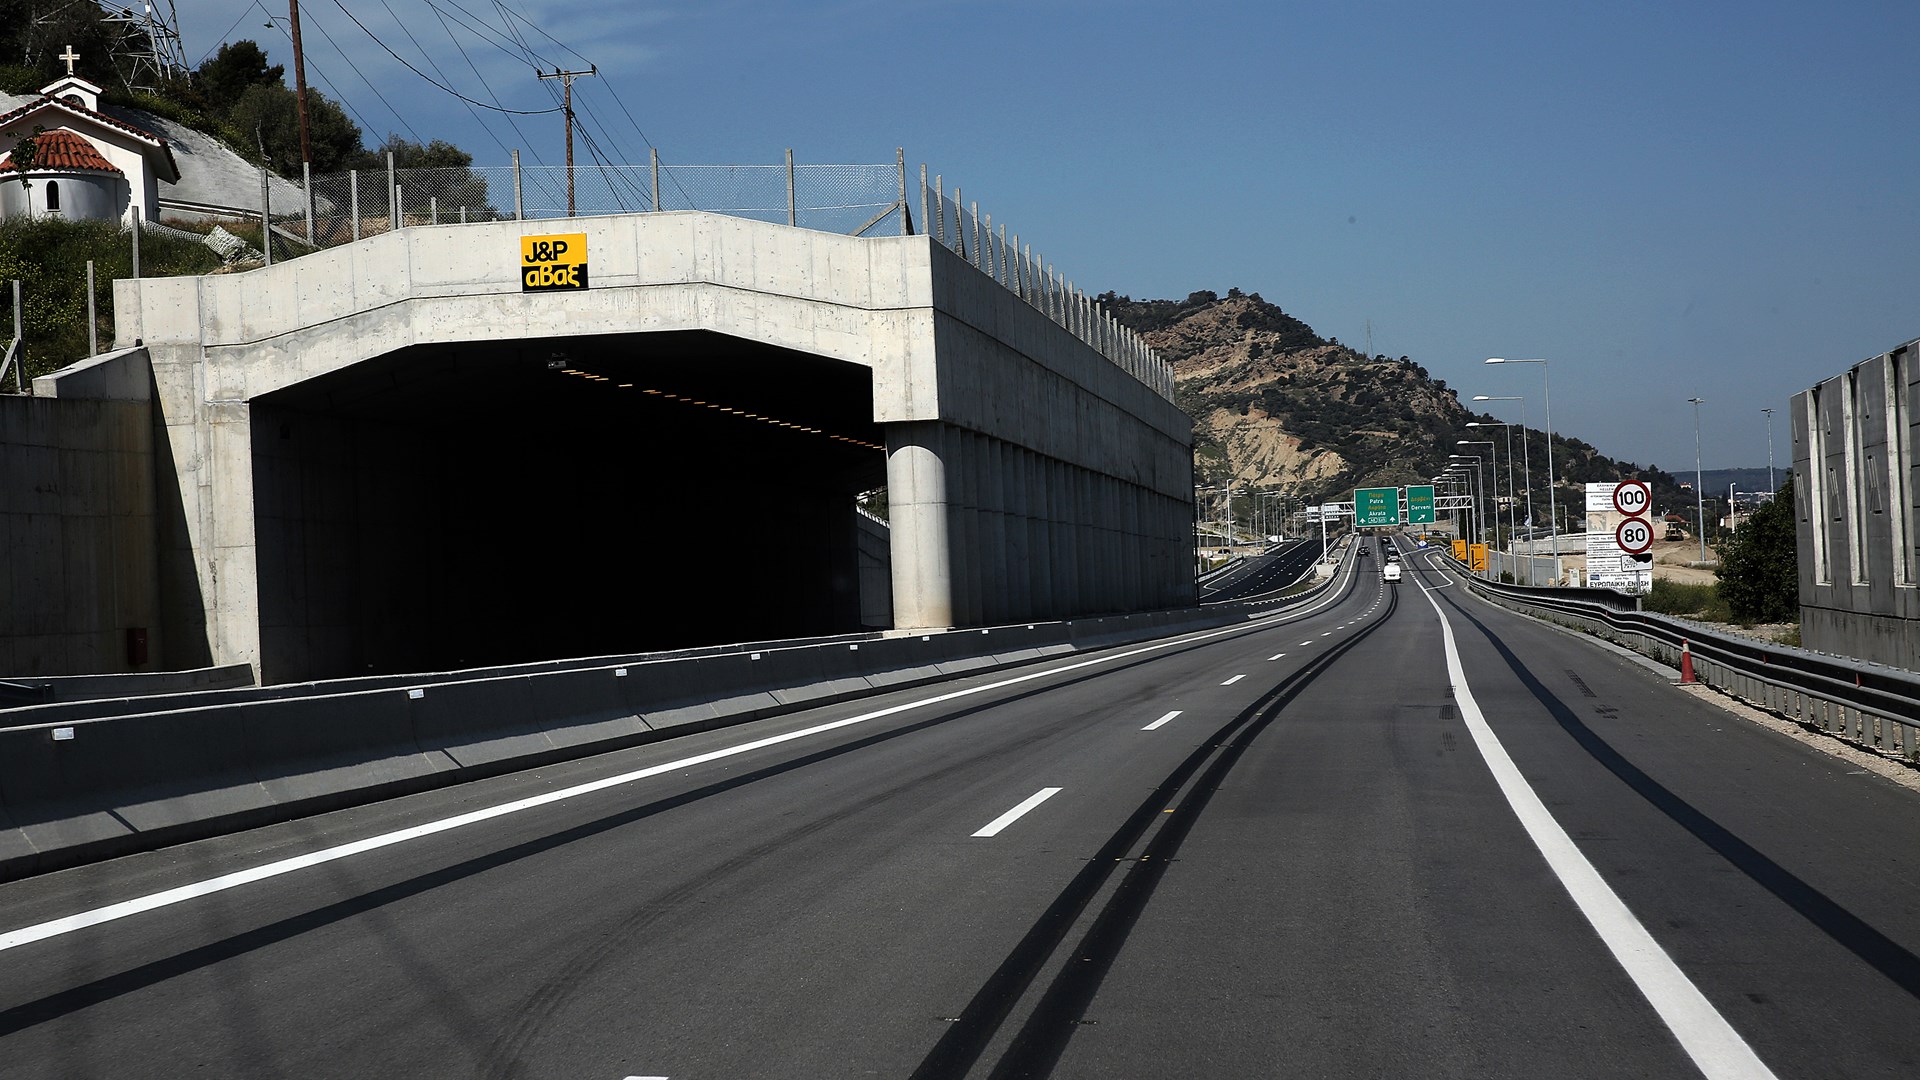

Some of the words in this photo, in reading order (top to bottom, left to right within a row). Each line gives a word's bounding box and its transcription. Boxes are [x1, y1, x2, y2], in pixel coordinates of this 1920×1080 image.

[525, 241, 568, 263] J&P
[1619, 490, 1645, 506] 100
[1625, 528, 1645, 543] 80
